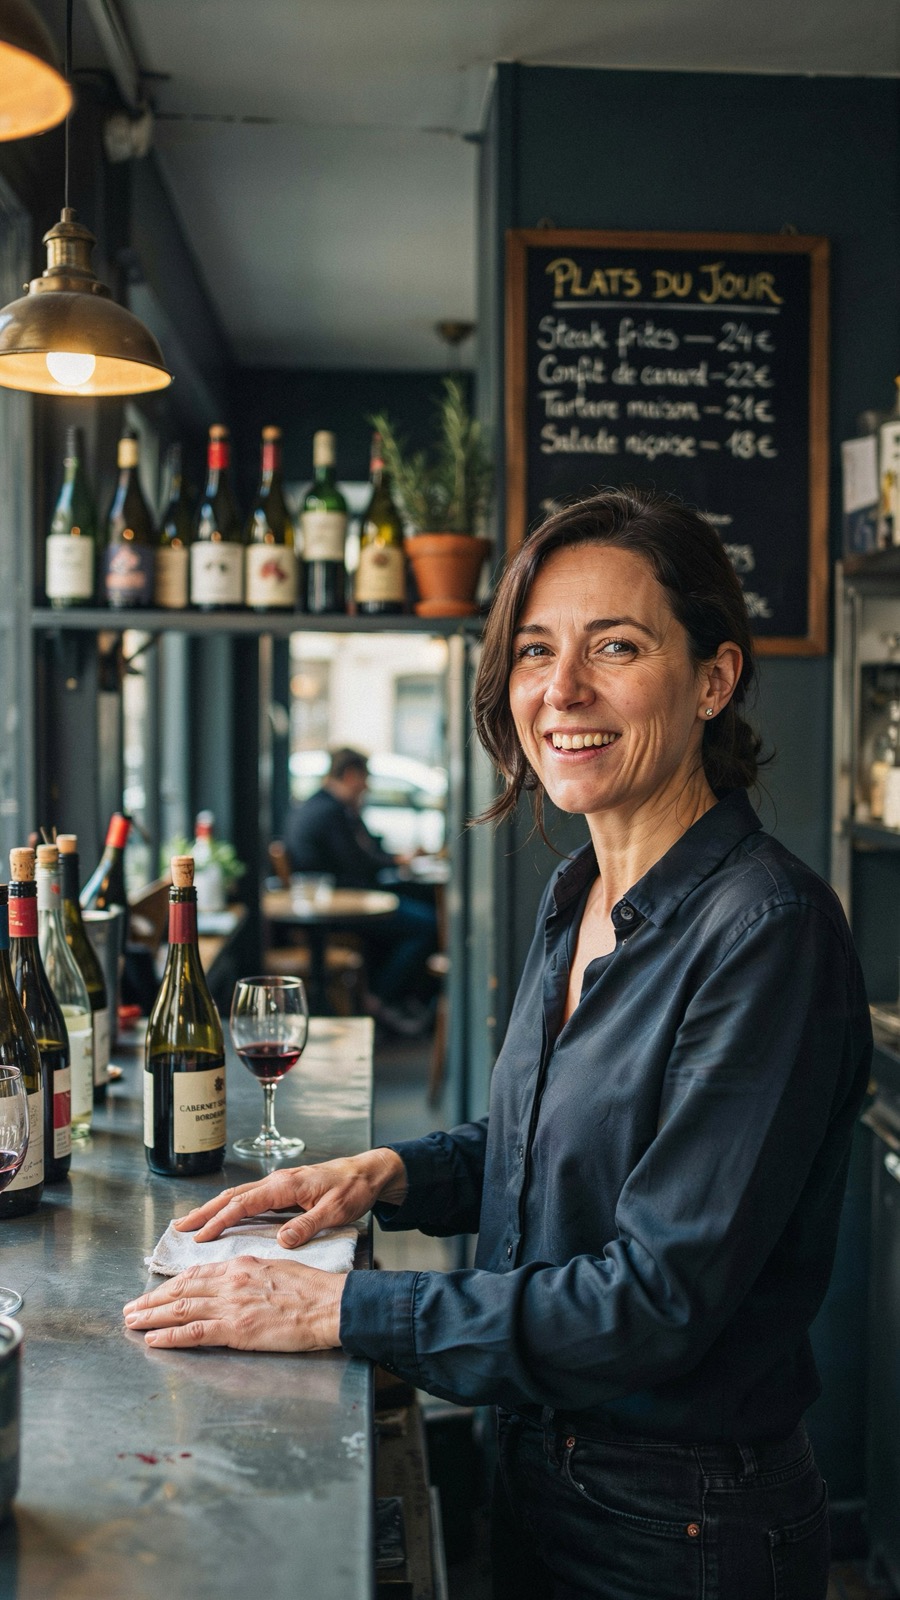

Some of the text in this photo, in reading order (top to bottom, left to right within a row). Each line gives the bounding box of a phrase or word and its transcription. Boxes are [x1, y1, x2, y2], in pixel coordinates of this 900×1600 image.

[545, 257, 784, 304] PLATS DU JOUR
[537, 316, 609, 351] Steak
[615, 317, 680, 358] frites
[717, 321, 775, 352] 24€
[537, 354, 608, 392] Confit
[611, 361, 638, 386] de
[725, 360, 774, 388] 22€
[538, 390, 619, 420] Tartare
[724, 394, 776, 423] 21€
[540, 423, 619, 455] Salade
[725, 429, 778, 459] 18€
[180, 1101, 217, 1112] CABERNET
